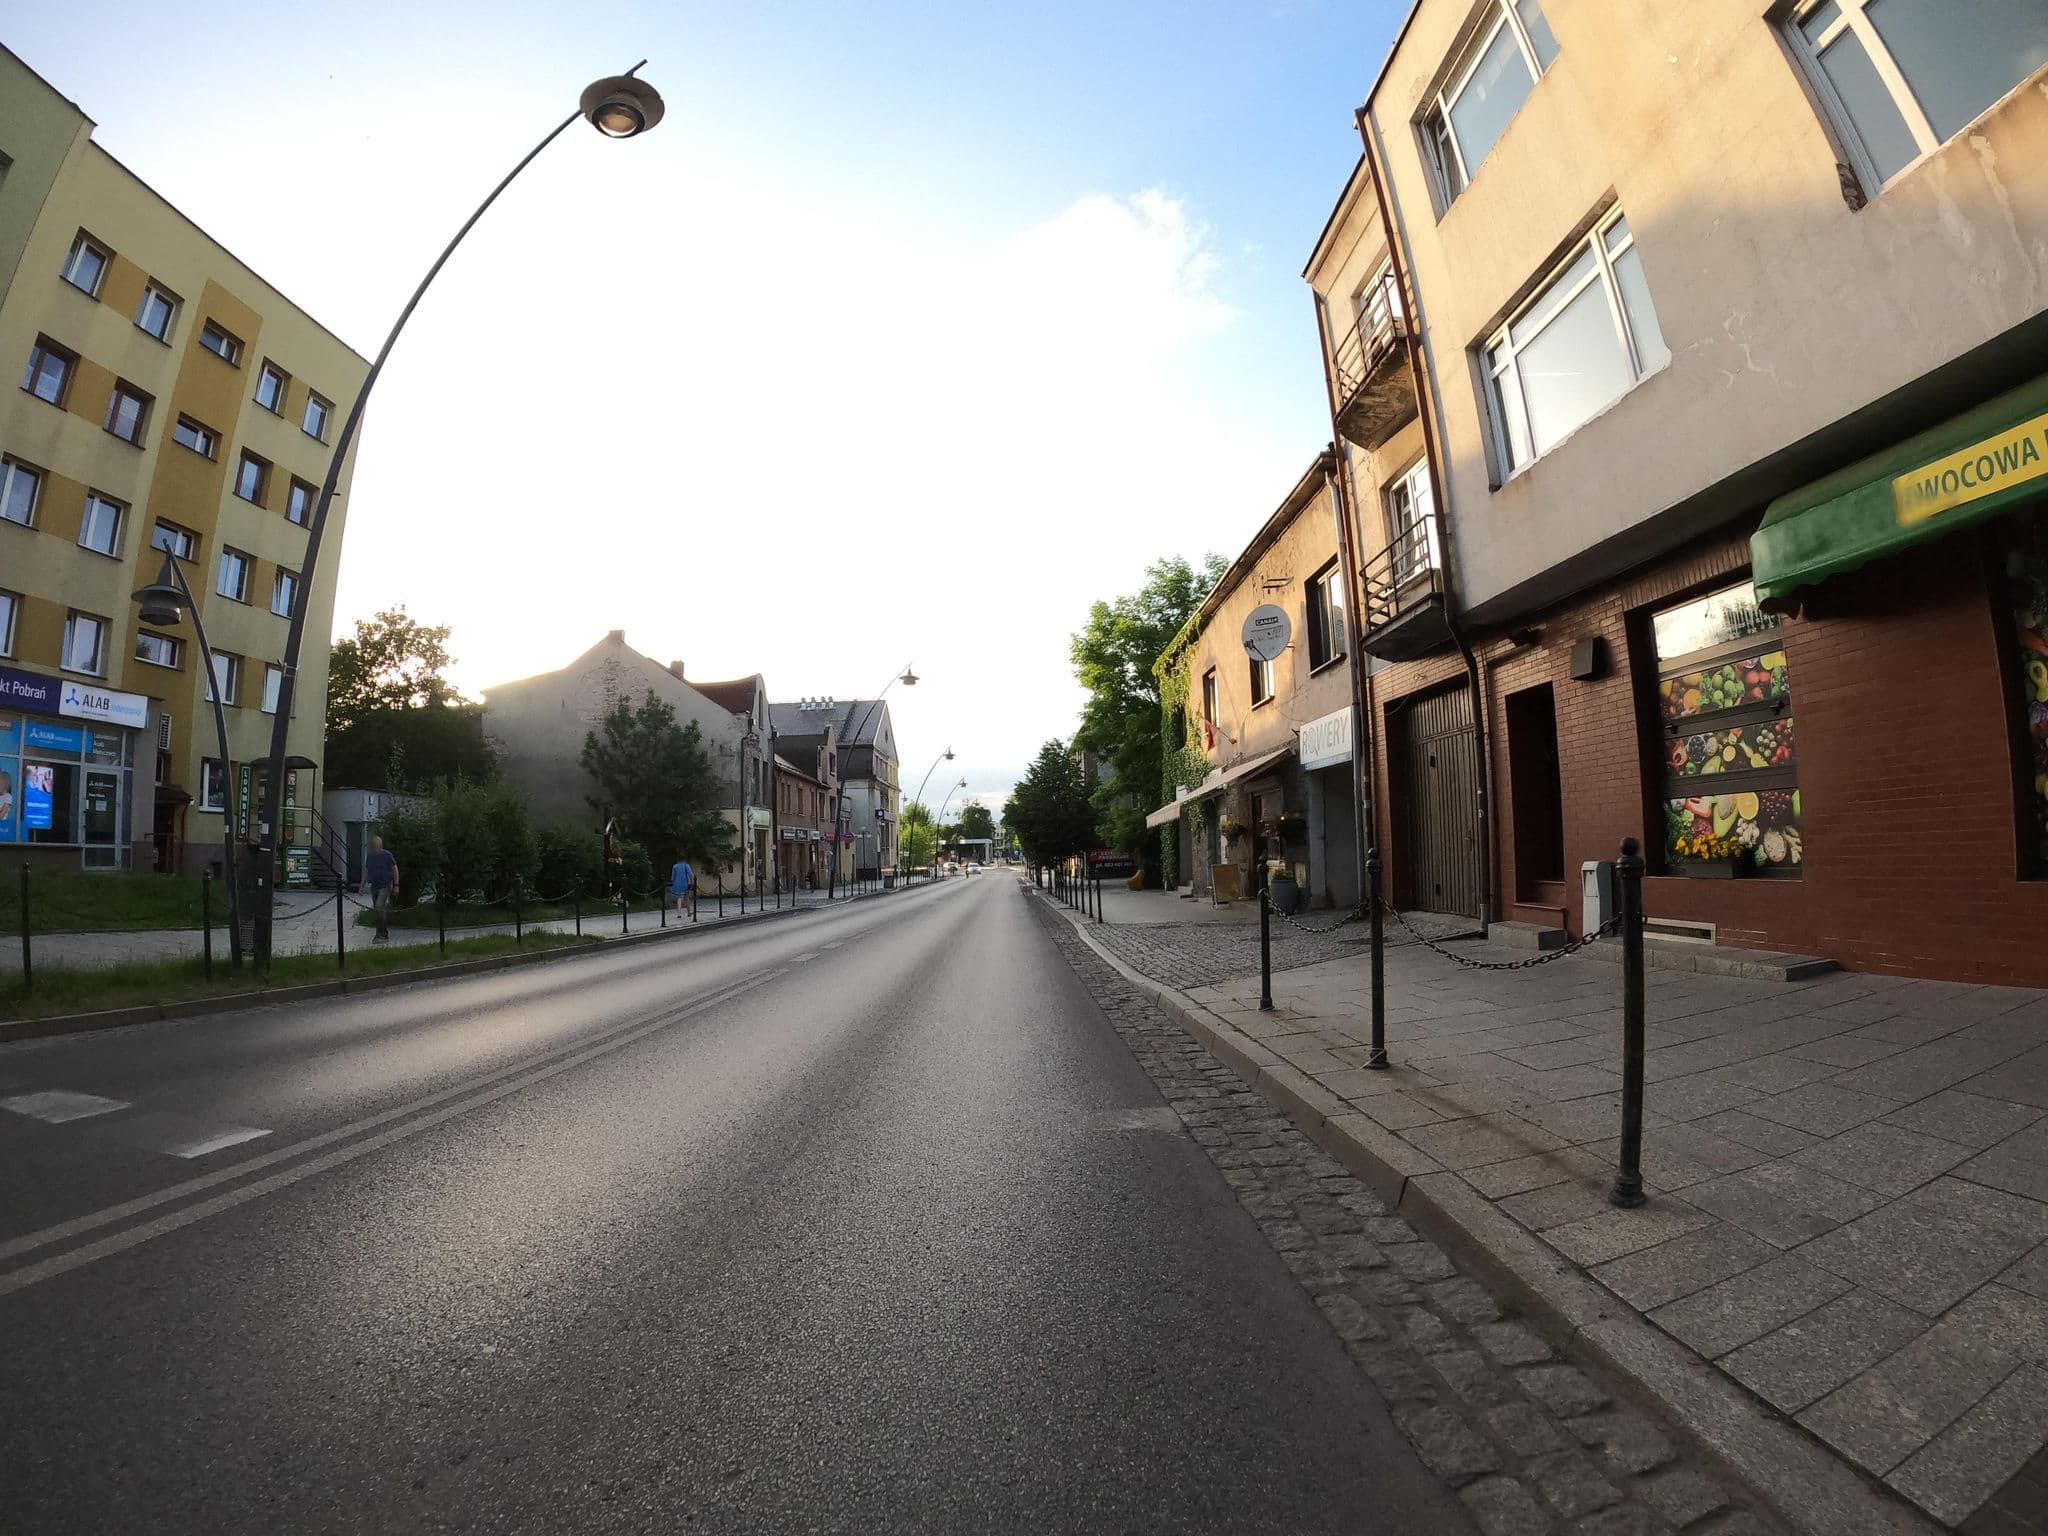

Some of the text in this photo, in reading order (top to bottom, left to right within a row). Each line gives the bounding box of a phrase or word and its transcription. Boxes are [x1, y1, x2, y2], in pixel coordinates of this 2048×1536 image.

[1905, 436, 2041, 501] WOCOWA
[12, 680, 46, 700] Pobrań
[82, 694, 110, 710] ALAB
[1301, 714, 1349, 757] ROWERY
